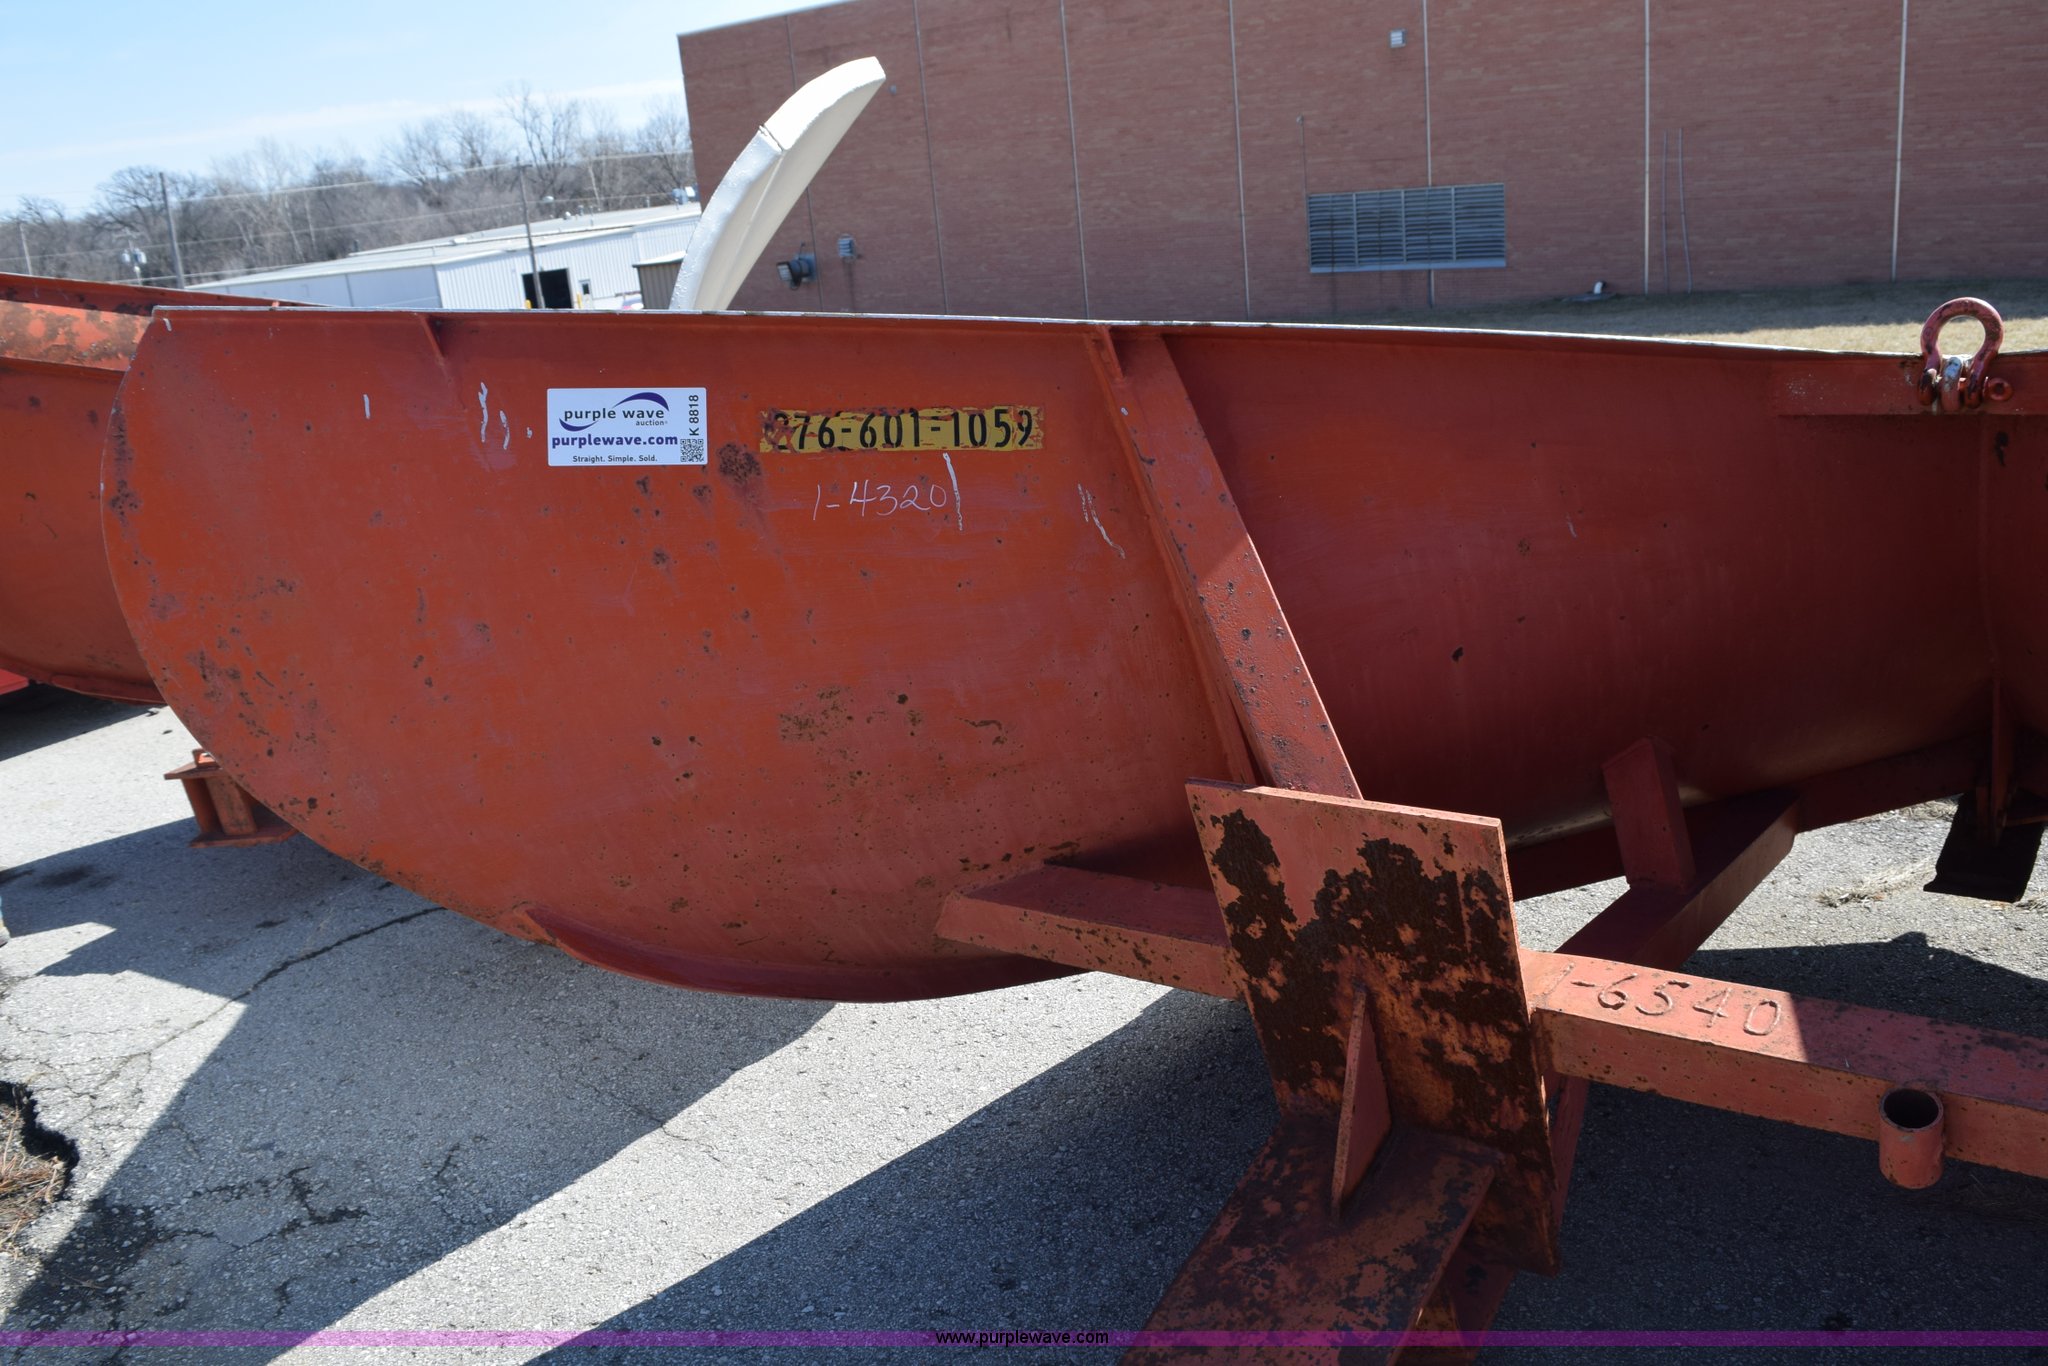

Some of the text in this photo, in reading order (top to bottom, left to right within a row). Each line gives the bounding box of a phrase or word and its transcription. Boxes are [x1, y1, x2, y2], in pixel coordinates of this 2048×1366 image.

[564, 408, 665, 421] purple wave
[688, 394, 700, 436] K 8818
[552, 433, 678, 449] purplewave.com
[572, 454, 658, 463] Straight. Simple. Sold.
